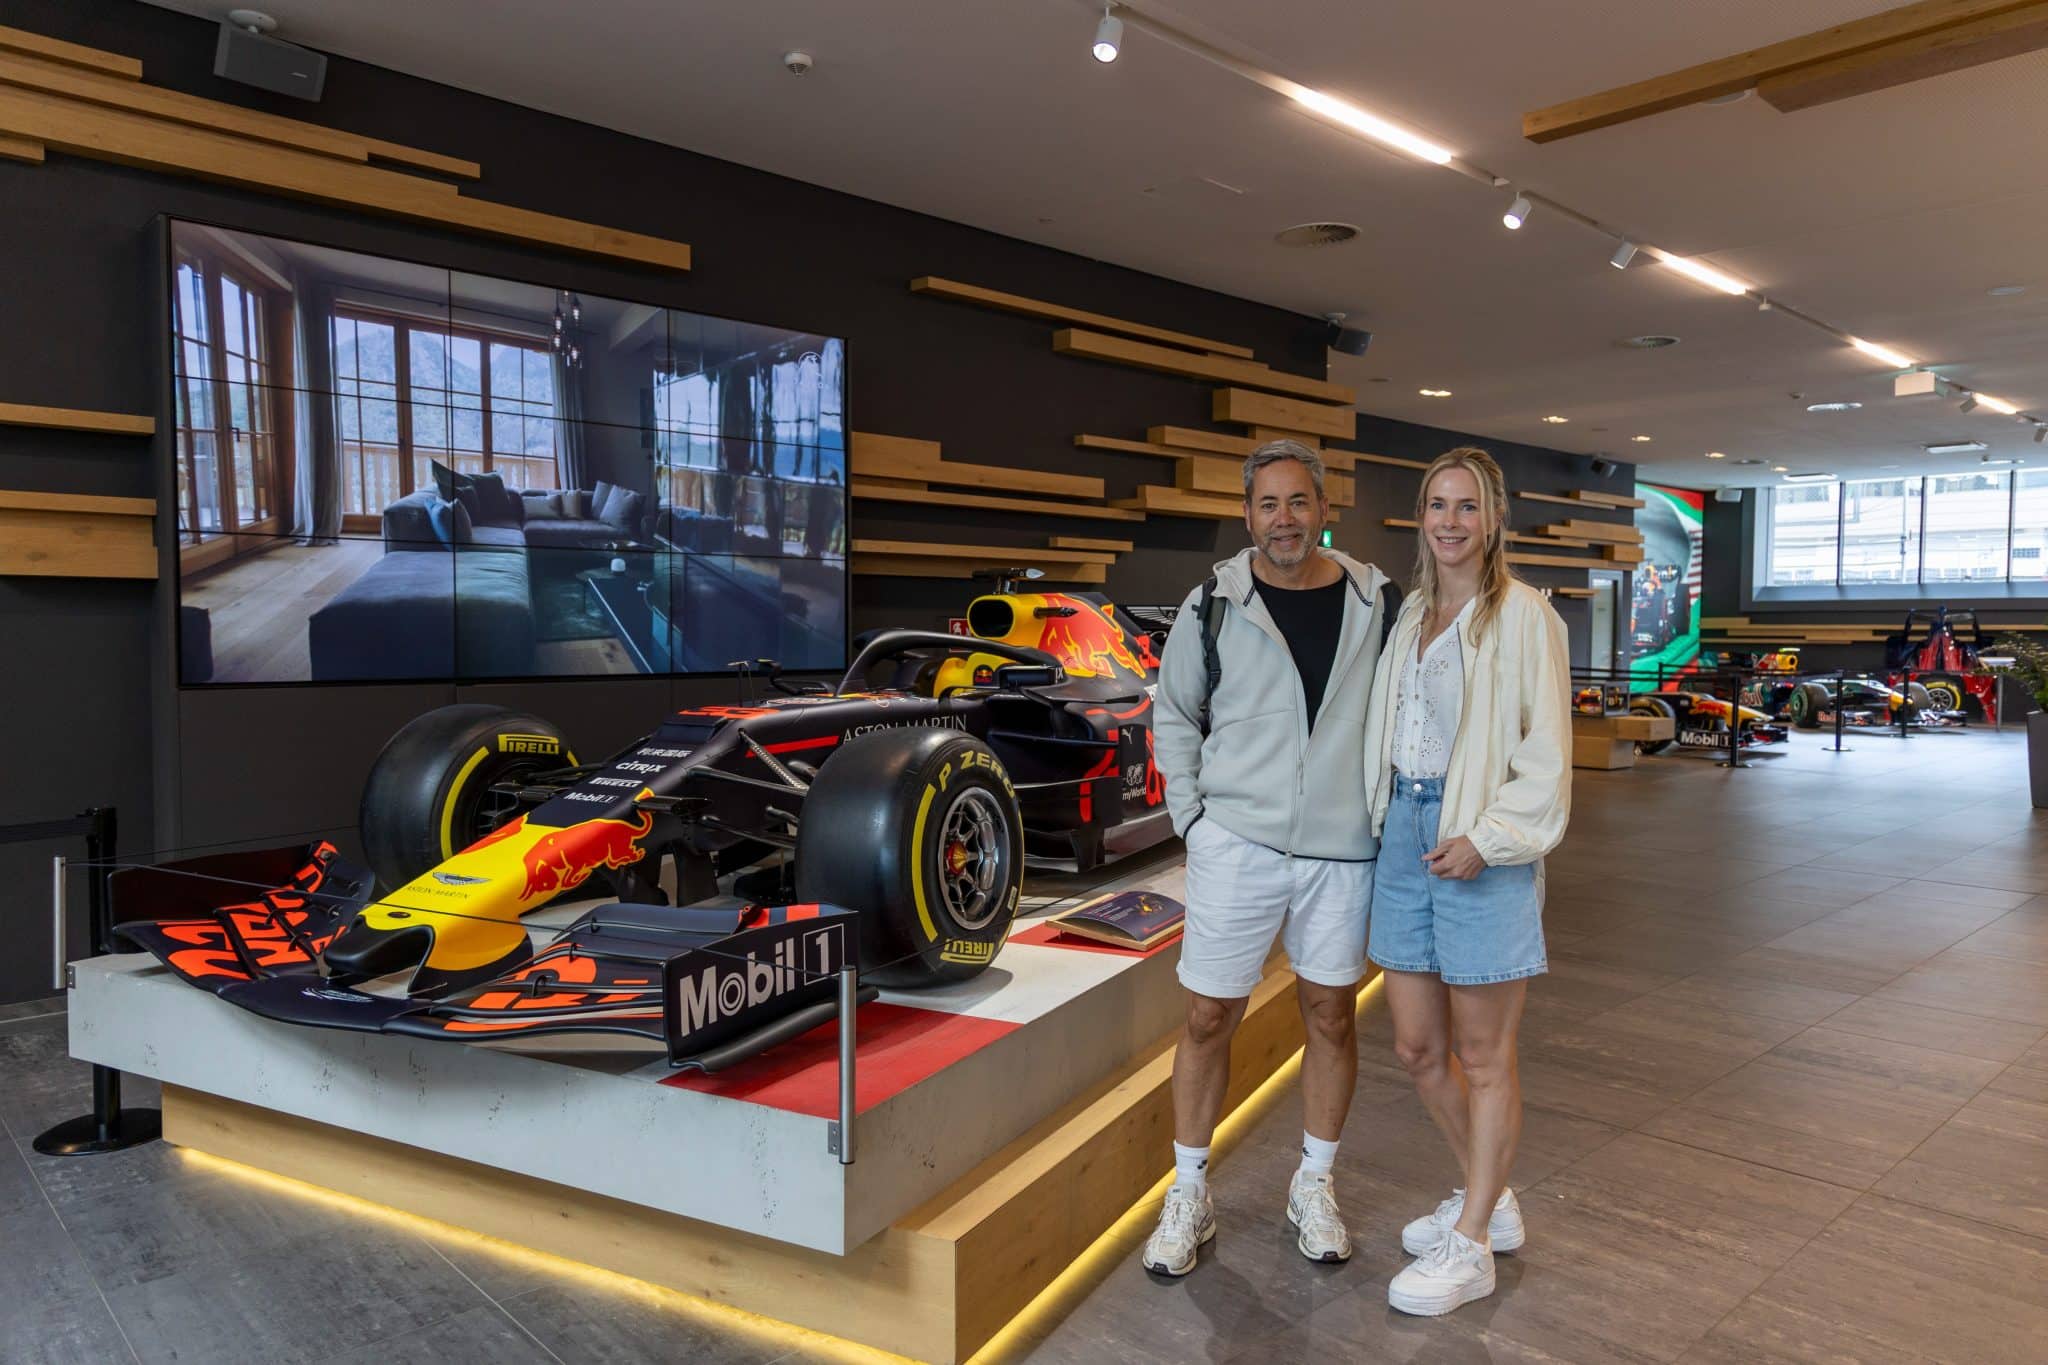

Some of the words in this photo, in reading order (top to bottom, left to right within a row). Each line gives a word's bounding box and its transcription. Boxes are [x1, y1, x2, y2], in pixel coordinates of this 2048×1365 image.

[498, 734, 560, 754] PIRELLI
[1681, 731, 1719, 746] Mobil
[589, 777, 643, 787] PIRELLI
[939, 762, 951, 792] P
[960, 750, 1015, 798] ZERO
[564, 792, 605, 802] Mobil
[940, 938, 994, 964] PIRELLI
[679, 938, 795, 1037] Mobil
